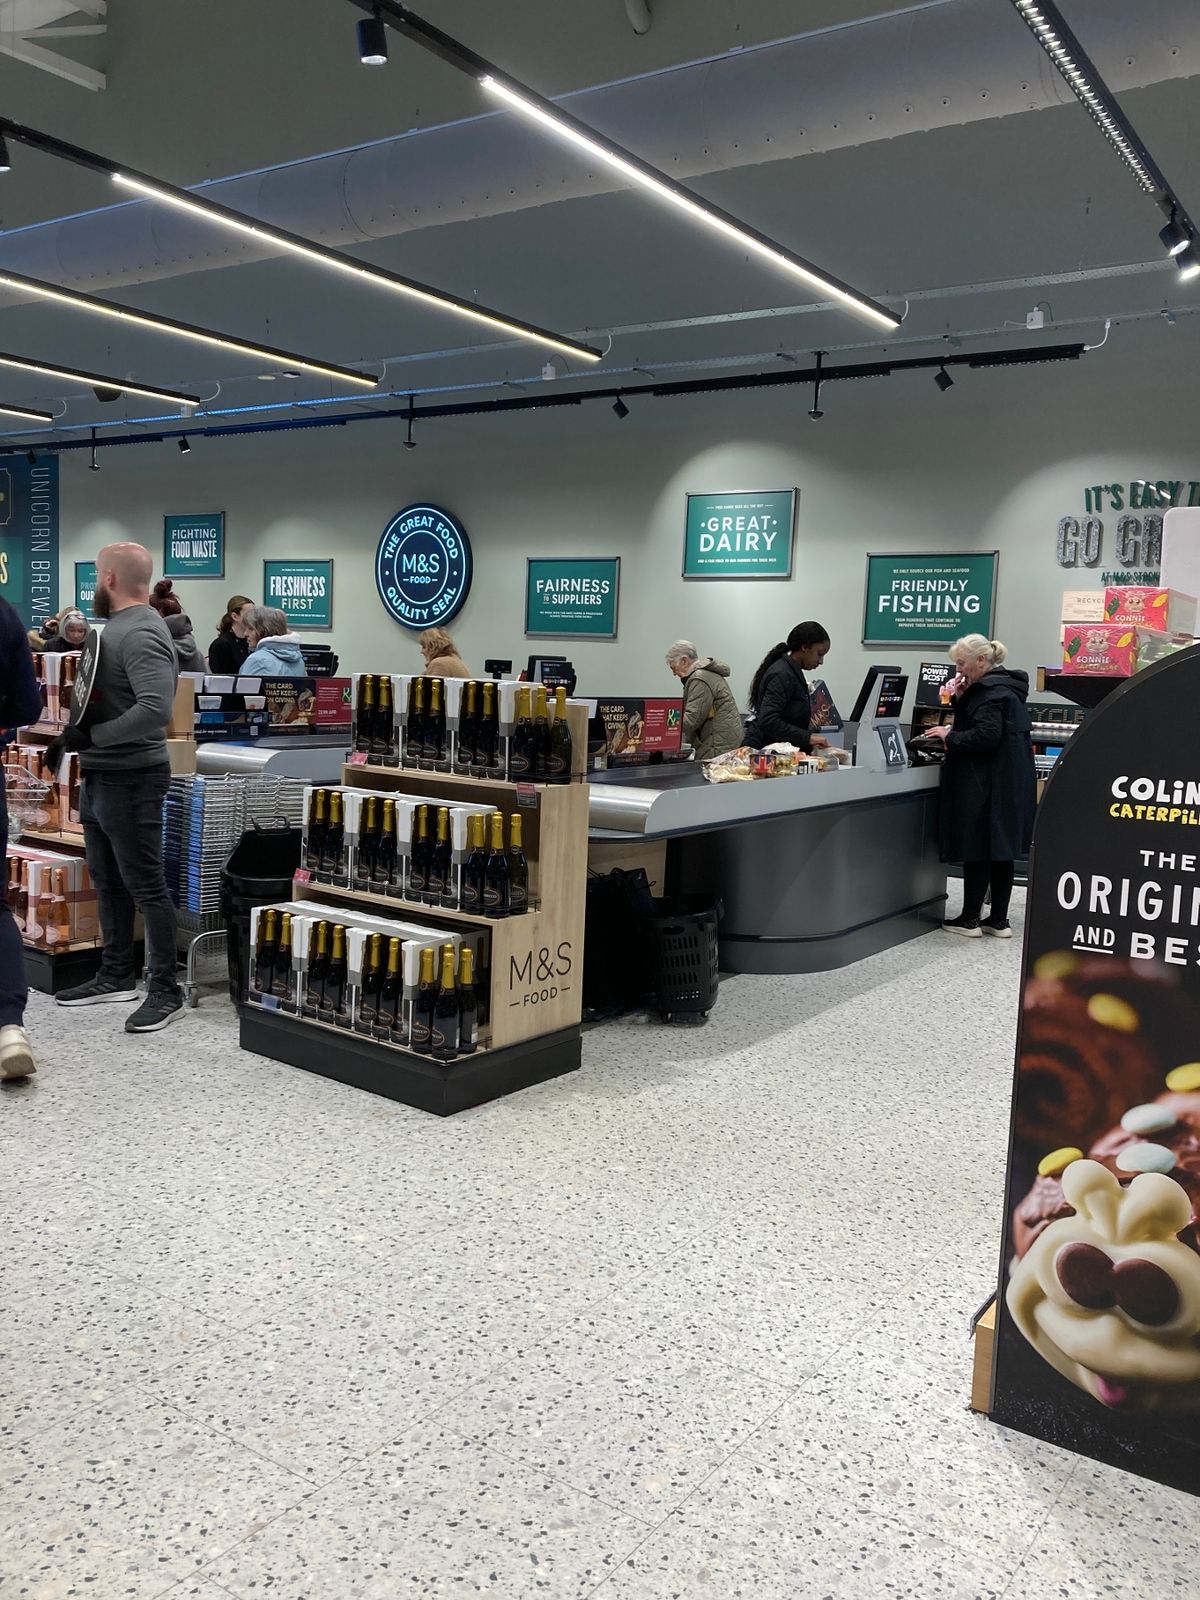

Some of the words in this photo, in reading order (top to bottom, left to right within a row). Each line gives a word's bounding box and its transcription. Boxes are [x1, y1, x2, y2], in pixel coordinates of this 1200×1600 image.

[1085, 484, 1123, 511] IT'S
[1129, 481, 1181, 507] EASY
[31, 467, 50, 552] UNICORN
[707, 515, 771, 532] GREAT
[171, 528, 217, 539] FIGHTING
[384, 533, 400, 559] THE
[400, 515, 435, 534] GREAT
[436, 522, 459, 559] FOOD
[699, 531, 778, 552] DAIRY
[1057, 515, 1101, 563] GO
[171, 540, 190, 559] FOOD
[192, 540, 217, 558] WASTE
[402, 553, 440, 573] M&S
[270, 575, 326, 597] FRESHNESS
[410, 575, 431, 584] FOOD
[536, 578, 610, 594] FAIRNESS
[891, 580, 968, 592] FRIENDLY
[80, 590, 95, 601] OUR
[281, 598, 314, 610] FIRST
[387, 586, 429, 620] QUALITY
[432, 587, 456, 615] SEAL
[551, 593, 602, 605] SUPPLIERS
[878, 594, 980, 613] FISHING
[922, 667, 949, 676] POWER
[923, 674, 947, 682] BOOST
[610, 705, 625, 713] CARD
[613, 713, 628, 721] KEEPS
[1139, 849, 1197, 872] THE
[1072, 924, 1116, 947] AND
[1129, 932, 1200, 966] BE
[509, 941, 572, 990] M&S
[523, 987, 558, 1007] FOOD
